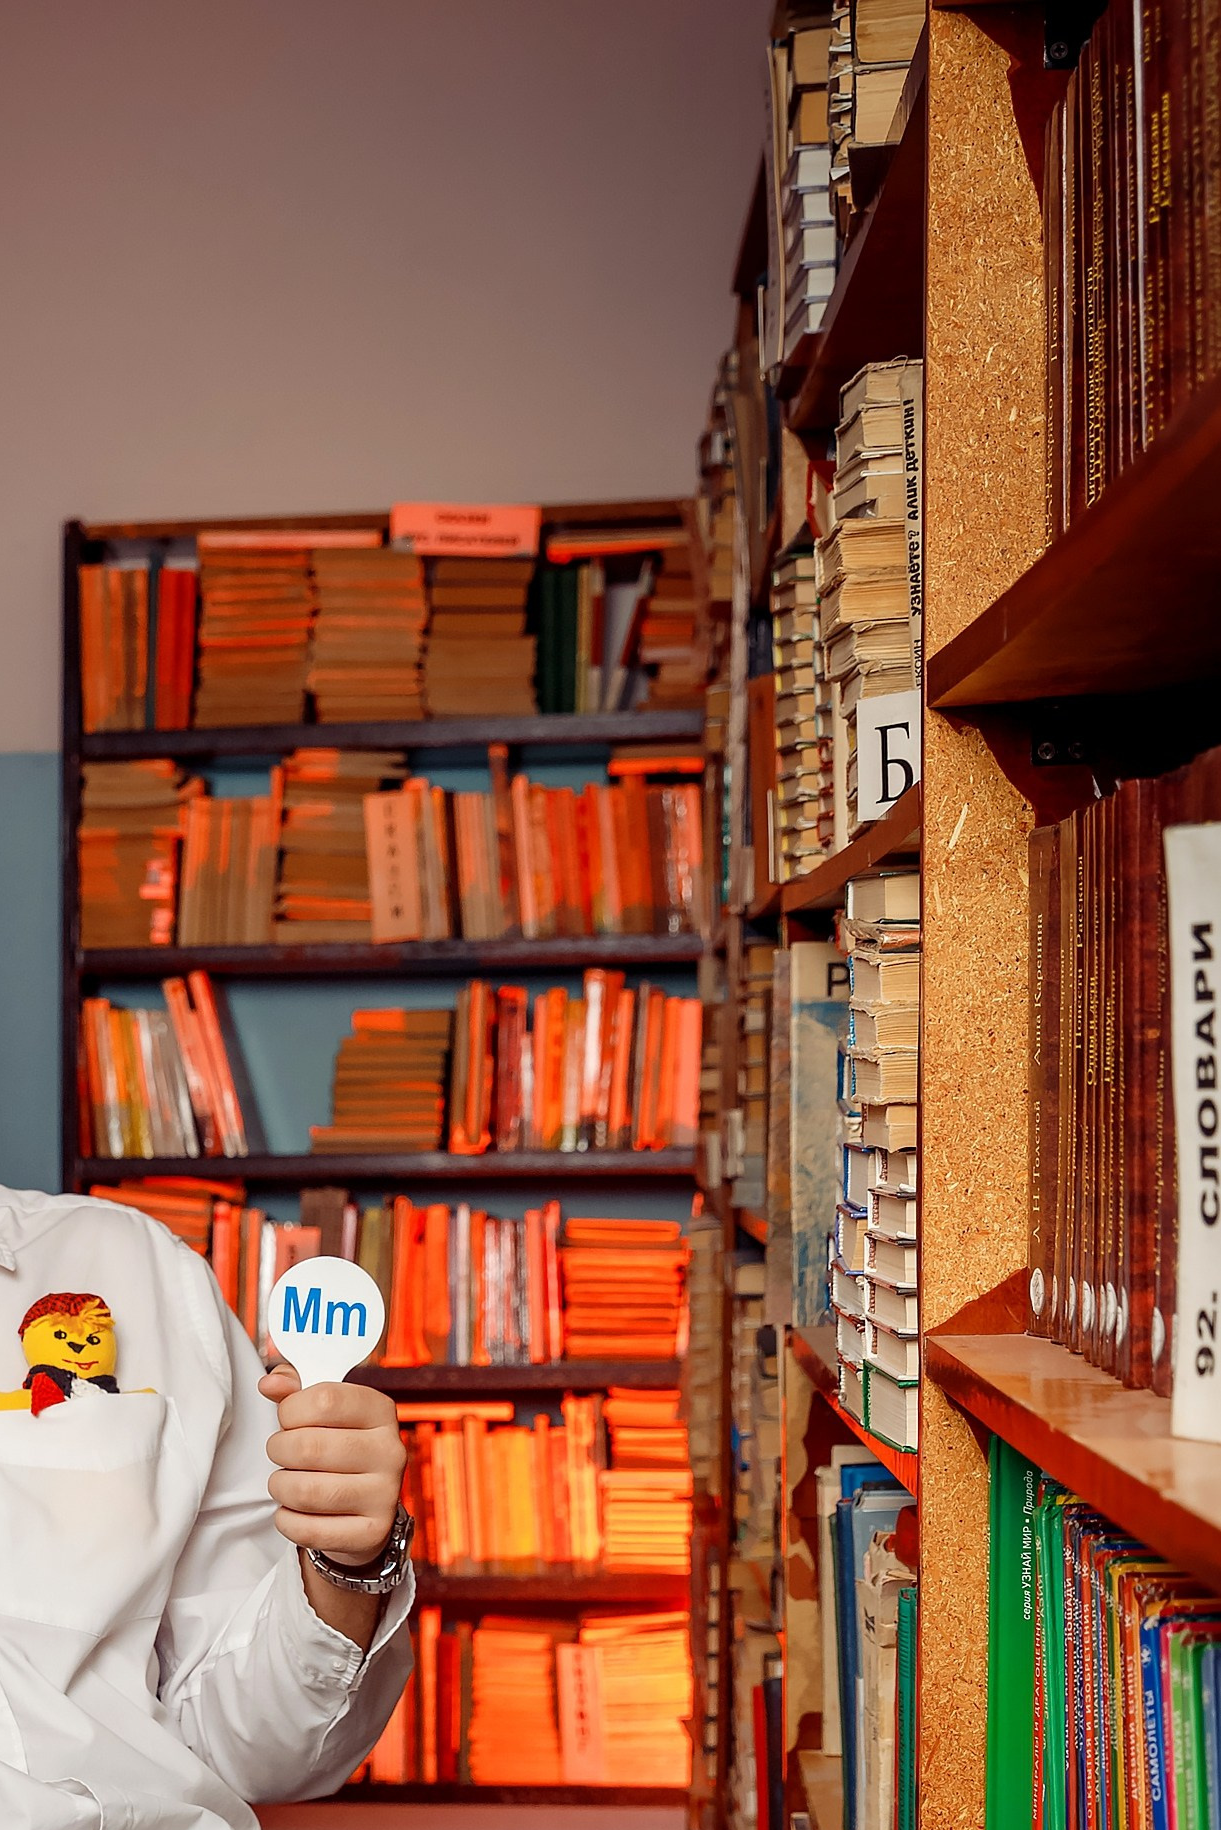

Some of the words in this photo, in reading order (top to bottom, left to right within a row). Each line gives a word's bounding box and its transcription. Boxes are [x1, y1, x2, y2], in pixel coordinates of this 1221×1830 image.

[1148, 110, 1161, 225] Рассказы
[875, 722, 914, 804] Б
[1076, 854, 1085, 948] Рассказы
[1033, 912, 1045, 1008] Каренина
[1033, 1014, 1043, 1067] Анна
[1075, 967, 1084, 1050] Повести
[1189, 922, 1220, 1228] СЛОВАРИ
[1032, 1099, 1043, 1184] Толстой
[282, 1286, 367, 1337] Mm
[1195, 1292, 1218, 1377] 92.
[1023, 1470, 1035, 1516] Природа
[1021, 1551, 1032, 1589] УЗНАЙ
[1022, 1525, 1032, 1550] МИР
[1023, 1590, 1033, 1620] серия
[1064, 1577, 1073, 1642] ЛОШАДИ
[1083, 1603, 1092, 1714] ИЗОБРЕТЕНИЯ
[1127, 1654, 1135, 1714] ЕГИПЕТ
[1032, 1734, 1040, 1820] МИНЕРАЛЫ
[1085, 1737, 1093, 1819] ОТКРЫТИЯ
[1129, 1722, 1138, 1800] ДРЕВНИЙ
[1145, 1690, 1162, 1802] САМОЛЕТЫ
[1174, 1710, 1184, 1774] ПАУКИ
